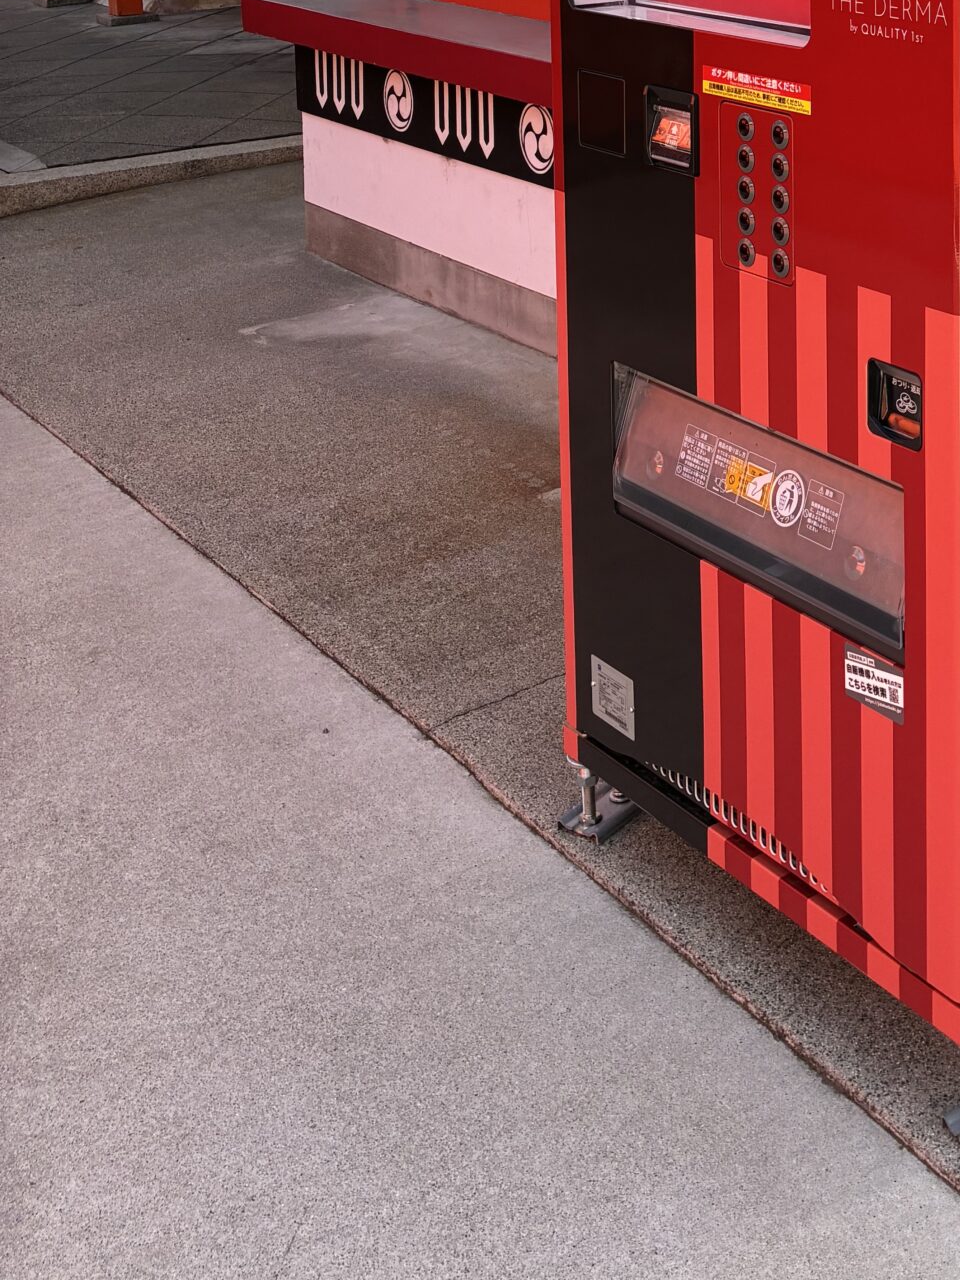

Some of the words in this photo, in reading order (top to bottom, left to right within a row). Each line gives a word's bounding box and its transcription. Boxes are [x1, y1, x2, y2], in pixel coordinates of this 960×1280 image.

[849, 19, 858, 34] by
[861, 23, 907, 41] QUALITY
[848, 677, 888, 699] こちらを検索
